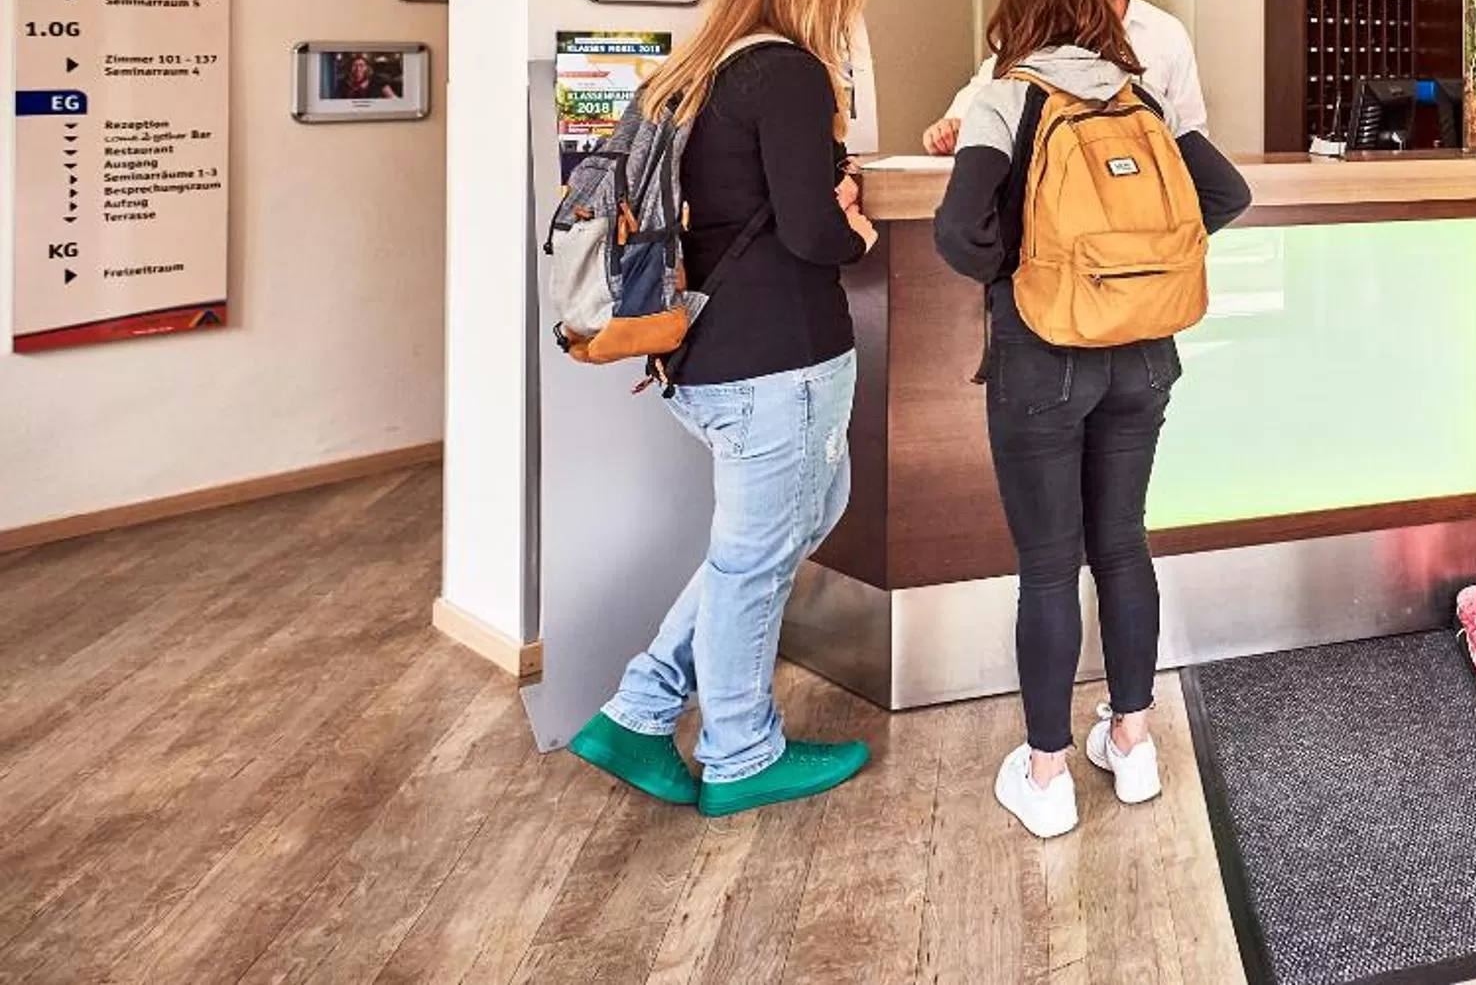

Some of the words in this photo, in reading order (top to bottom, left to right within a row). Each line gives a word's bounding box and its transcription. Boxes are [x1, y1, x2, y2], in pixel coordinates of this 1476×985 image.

[25, 21, 81, 37] 1.OG
[104, 55, 153, 64] Zimmer
[158, 55, 182, 64] 101
[195, 54, 218, 64] 137
[104, 67, 189, 77] Seminarraum
[51, 95, 80, 111] EG
[577, 102, 610, 114] 2018
[104, 120, 170, 131] Rezeption
[191, 129, 212, 139] Bar
[104, 145, 174, 155] Restaurant
[104, 159, 158, 170] Ausgang
[104, 170, 195, 182] Seminarräume
[104, 182, 221, 196] Besprechungsraum
[103, 199, 149, 208] Aufzug
[103, 212, 156, 222] Terrasse
[48, 243, 78, 259] KG
[103, 263, 184, 278] Freizeitraum
